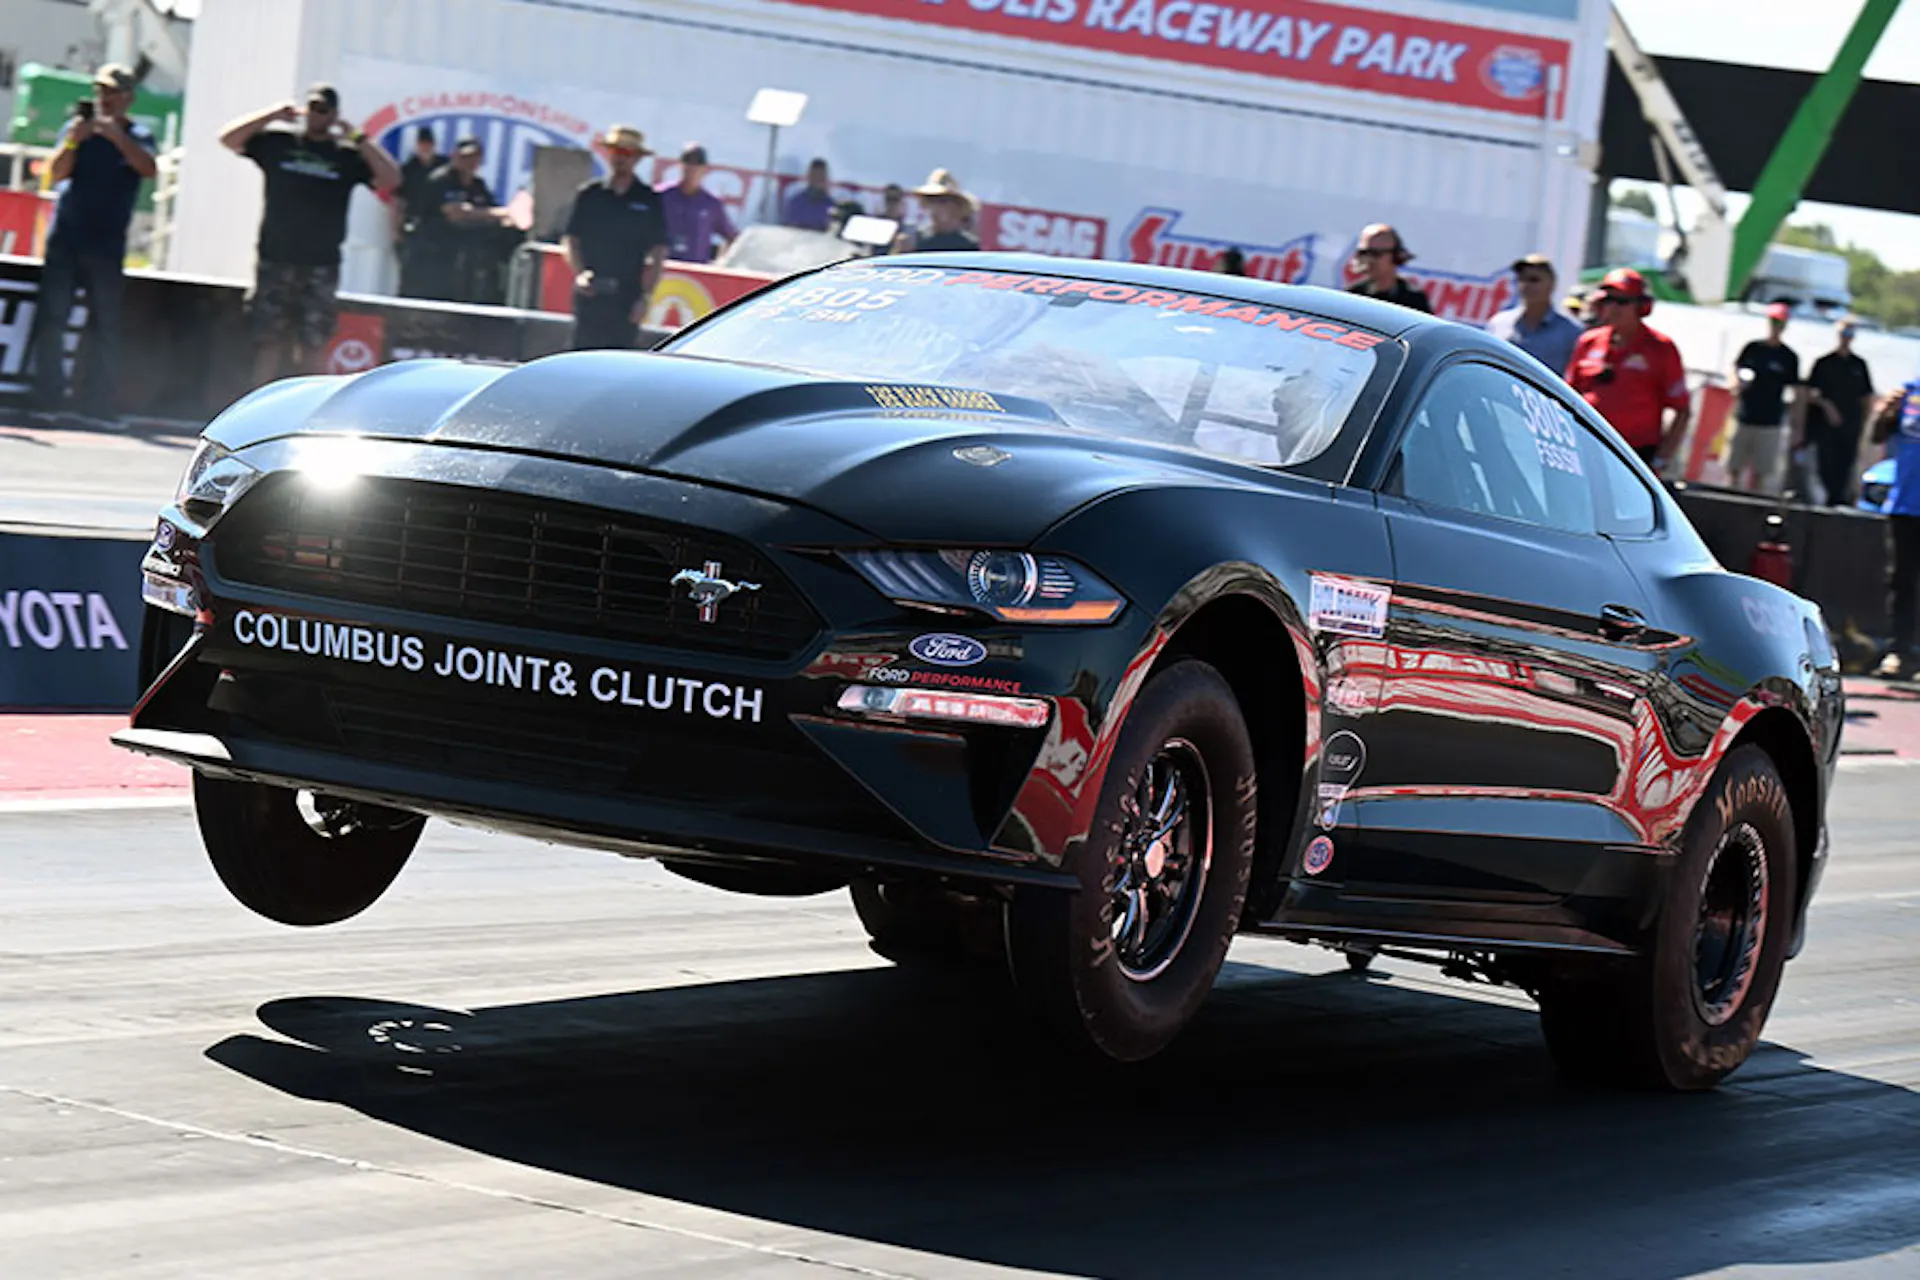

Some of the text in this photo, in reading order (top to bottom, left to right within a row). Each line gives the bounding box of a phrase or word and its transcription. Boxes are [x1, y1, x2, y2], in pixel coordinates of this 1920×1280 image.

[1083, 0, 1333, 62] RACEWAY
[1331, 26, 1469, 84] PARK
[997, 208, 1098, 259] SCAG
[943, 271, 1384, 351] PERFORMANCE
[233, 609, 763, 722] COLUMBUS JOINT& CLUTCH
[868, 666, 1022, 694] FORD PERFORMANCE
[923, 637, 974, 662] Ford
